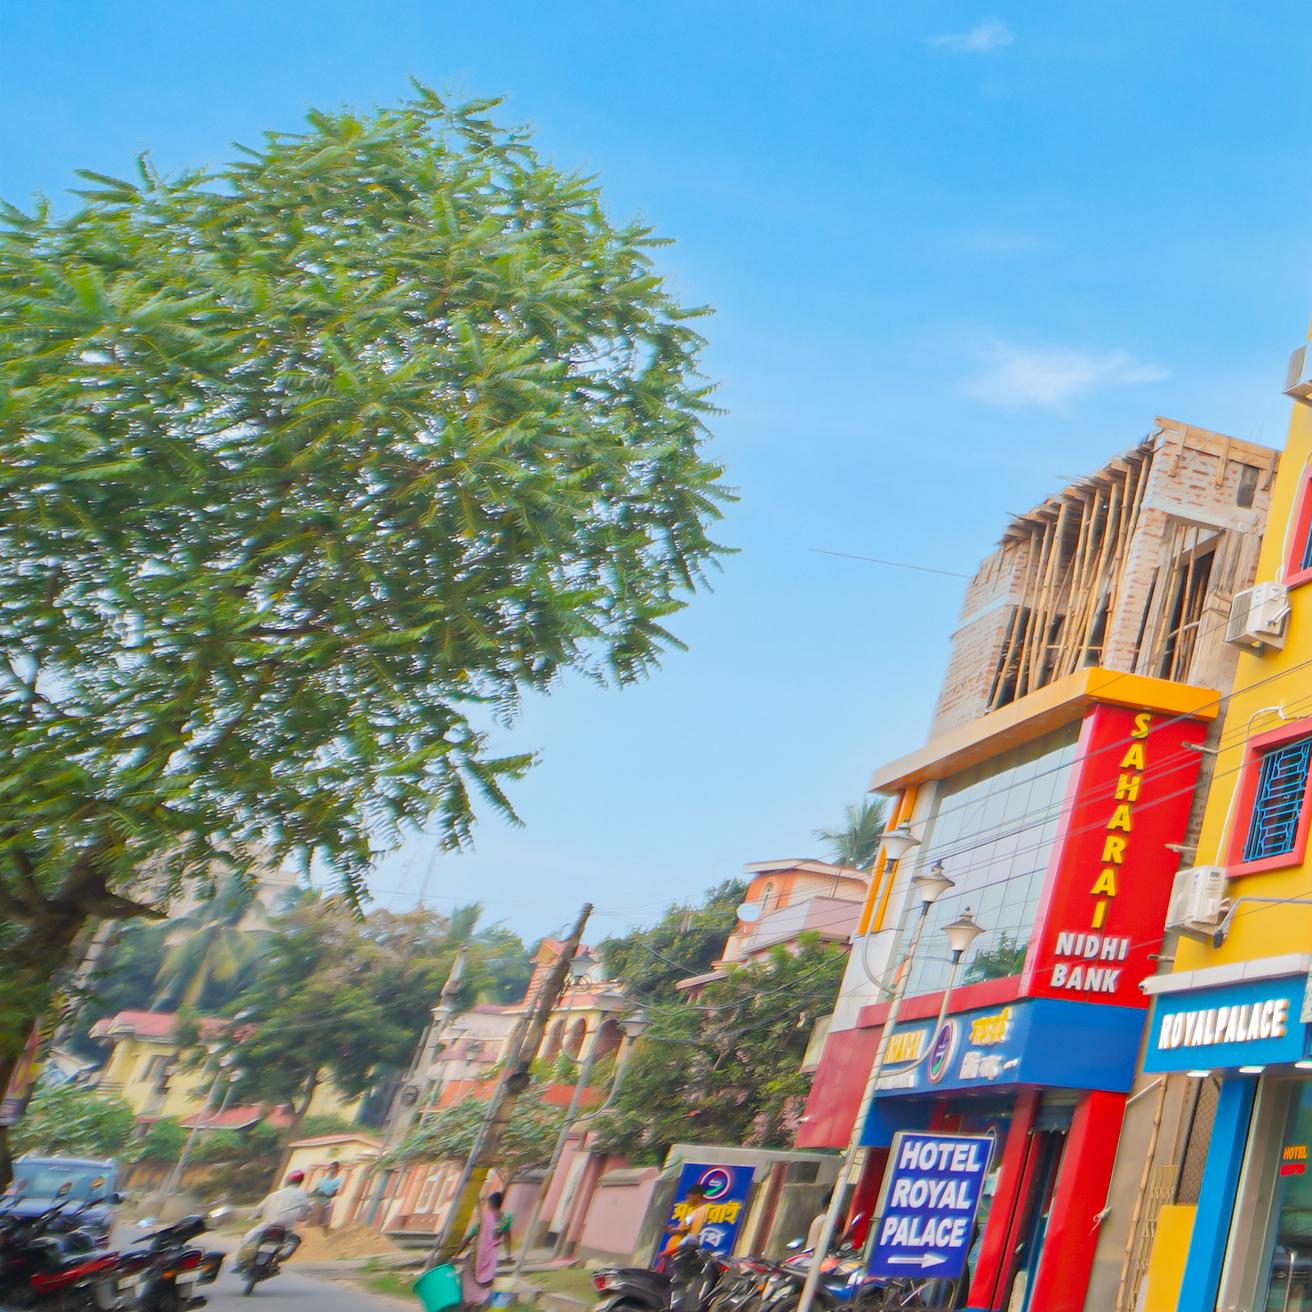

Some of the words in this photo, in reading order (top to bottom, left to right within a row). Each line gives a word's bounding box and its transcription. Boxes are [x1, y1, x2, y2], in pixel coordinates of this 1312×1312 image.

[1090, 712, 1151, 929] SAHARAI
[1055, 932, 1129, 961] NIDHI
[1050, 964, 1122, 993] BANK
[899, 1141, 981, 1173] HOTEL
[1282, 1145, 1307, 1161] HOTEL
[891, 1179, 972, 1210] ROYAL
[880, 1217, 967, 1248] PALACE
